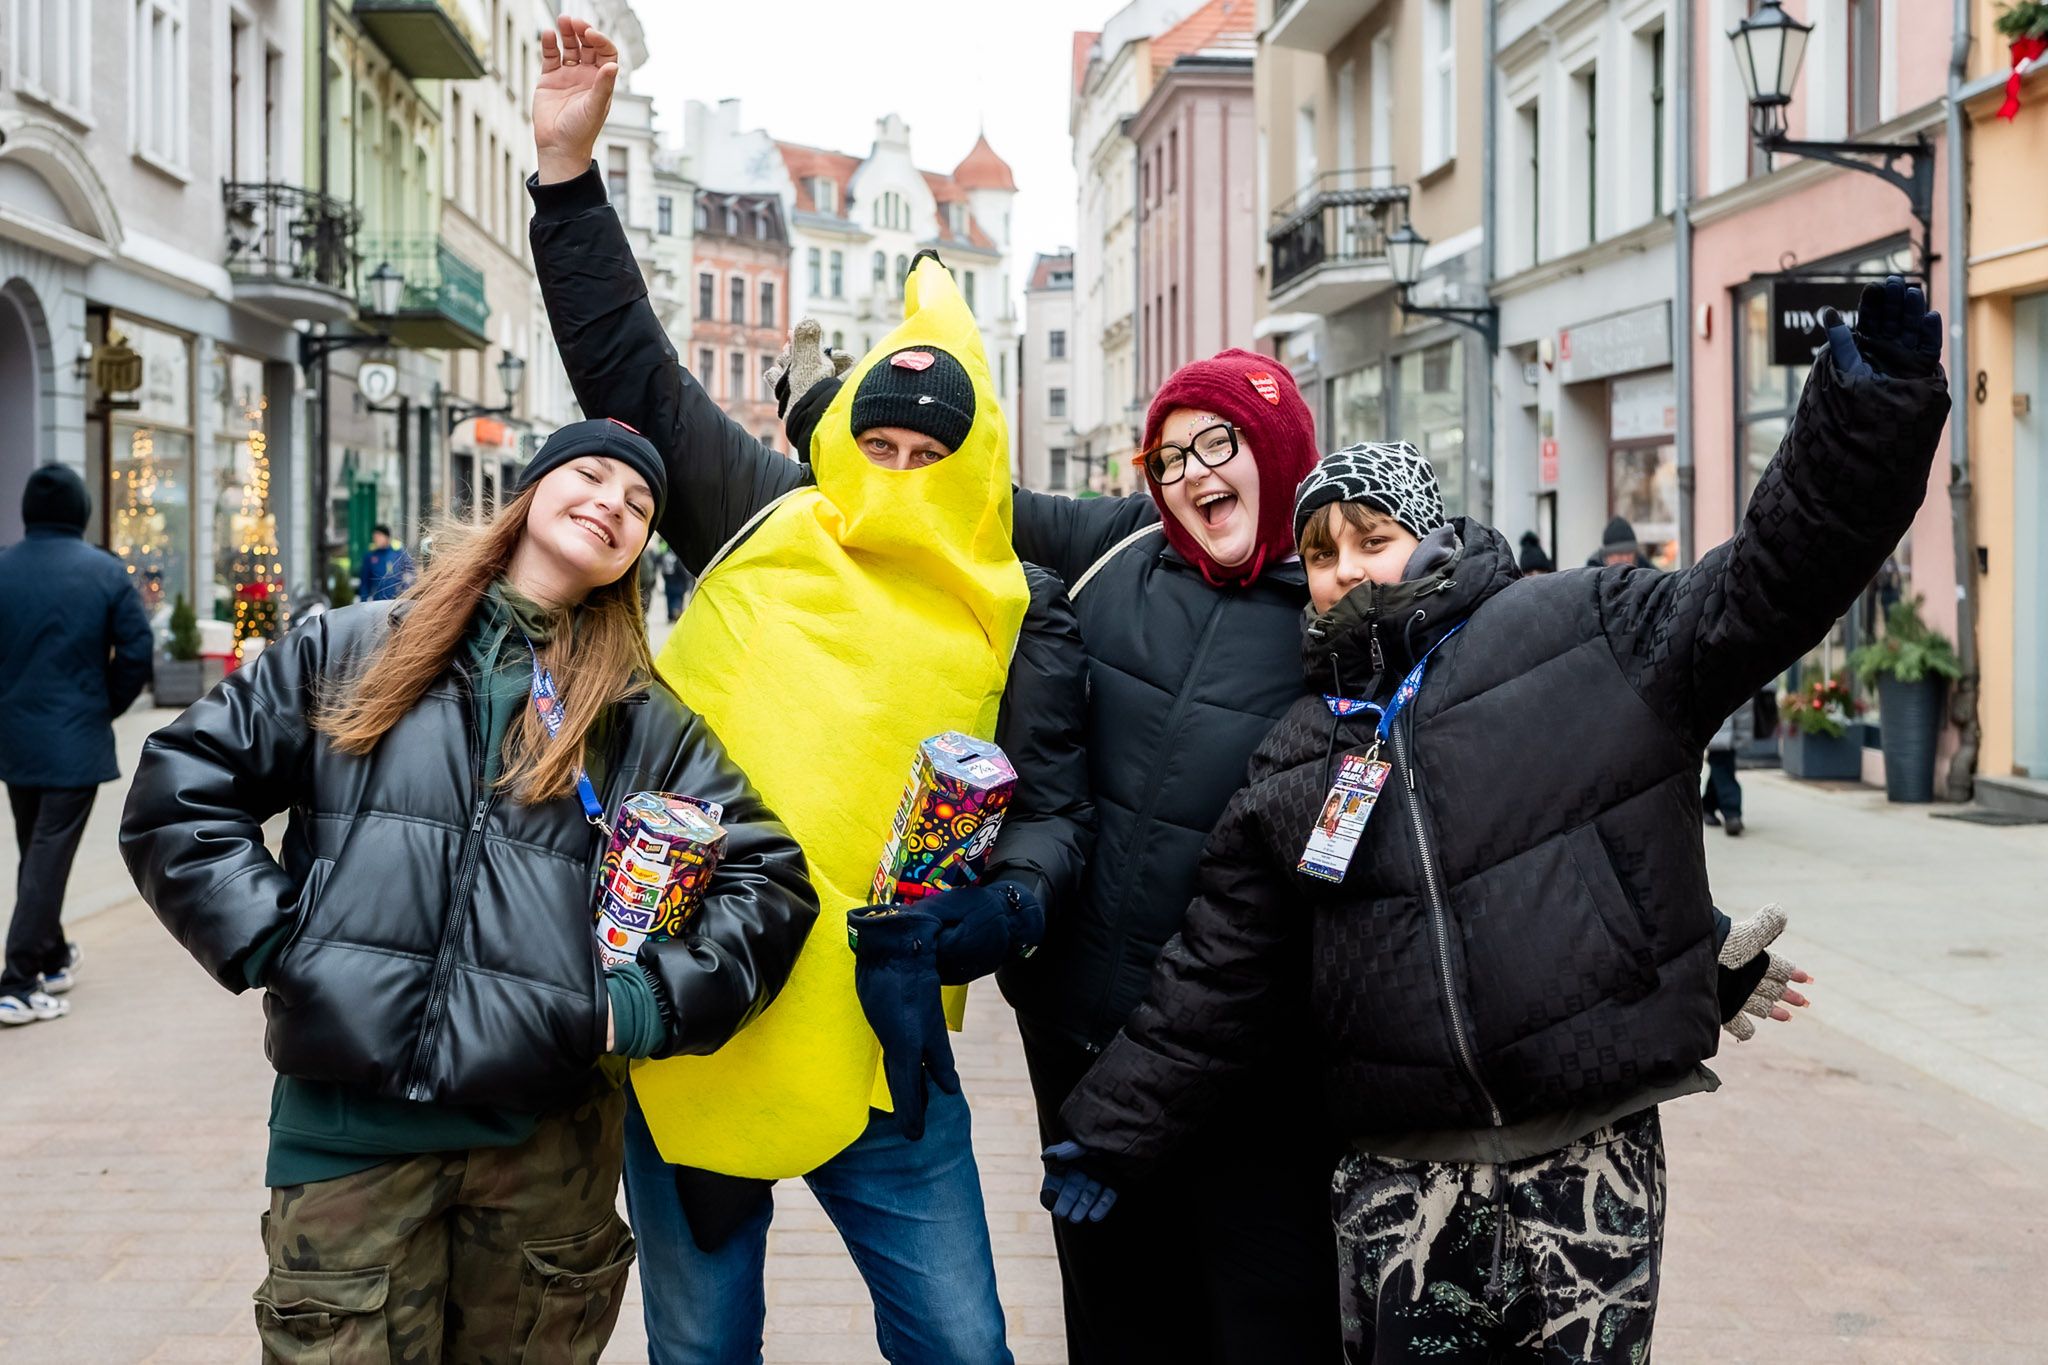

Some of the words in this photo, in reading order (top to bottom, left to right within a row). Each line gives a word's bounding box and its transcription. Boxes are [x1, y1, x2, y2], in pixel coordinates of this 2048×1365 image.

[1975, 370, 1988, 405] 8
[619, 881, 653, 904] mBank
[609, 901, 646, 924] PLAY
